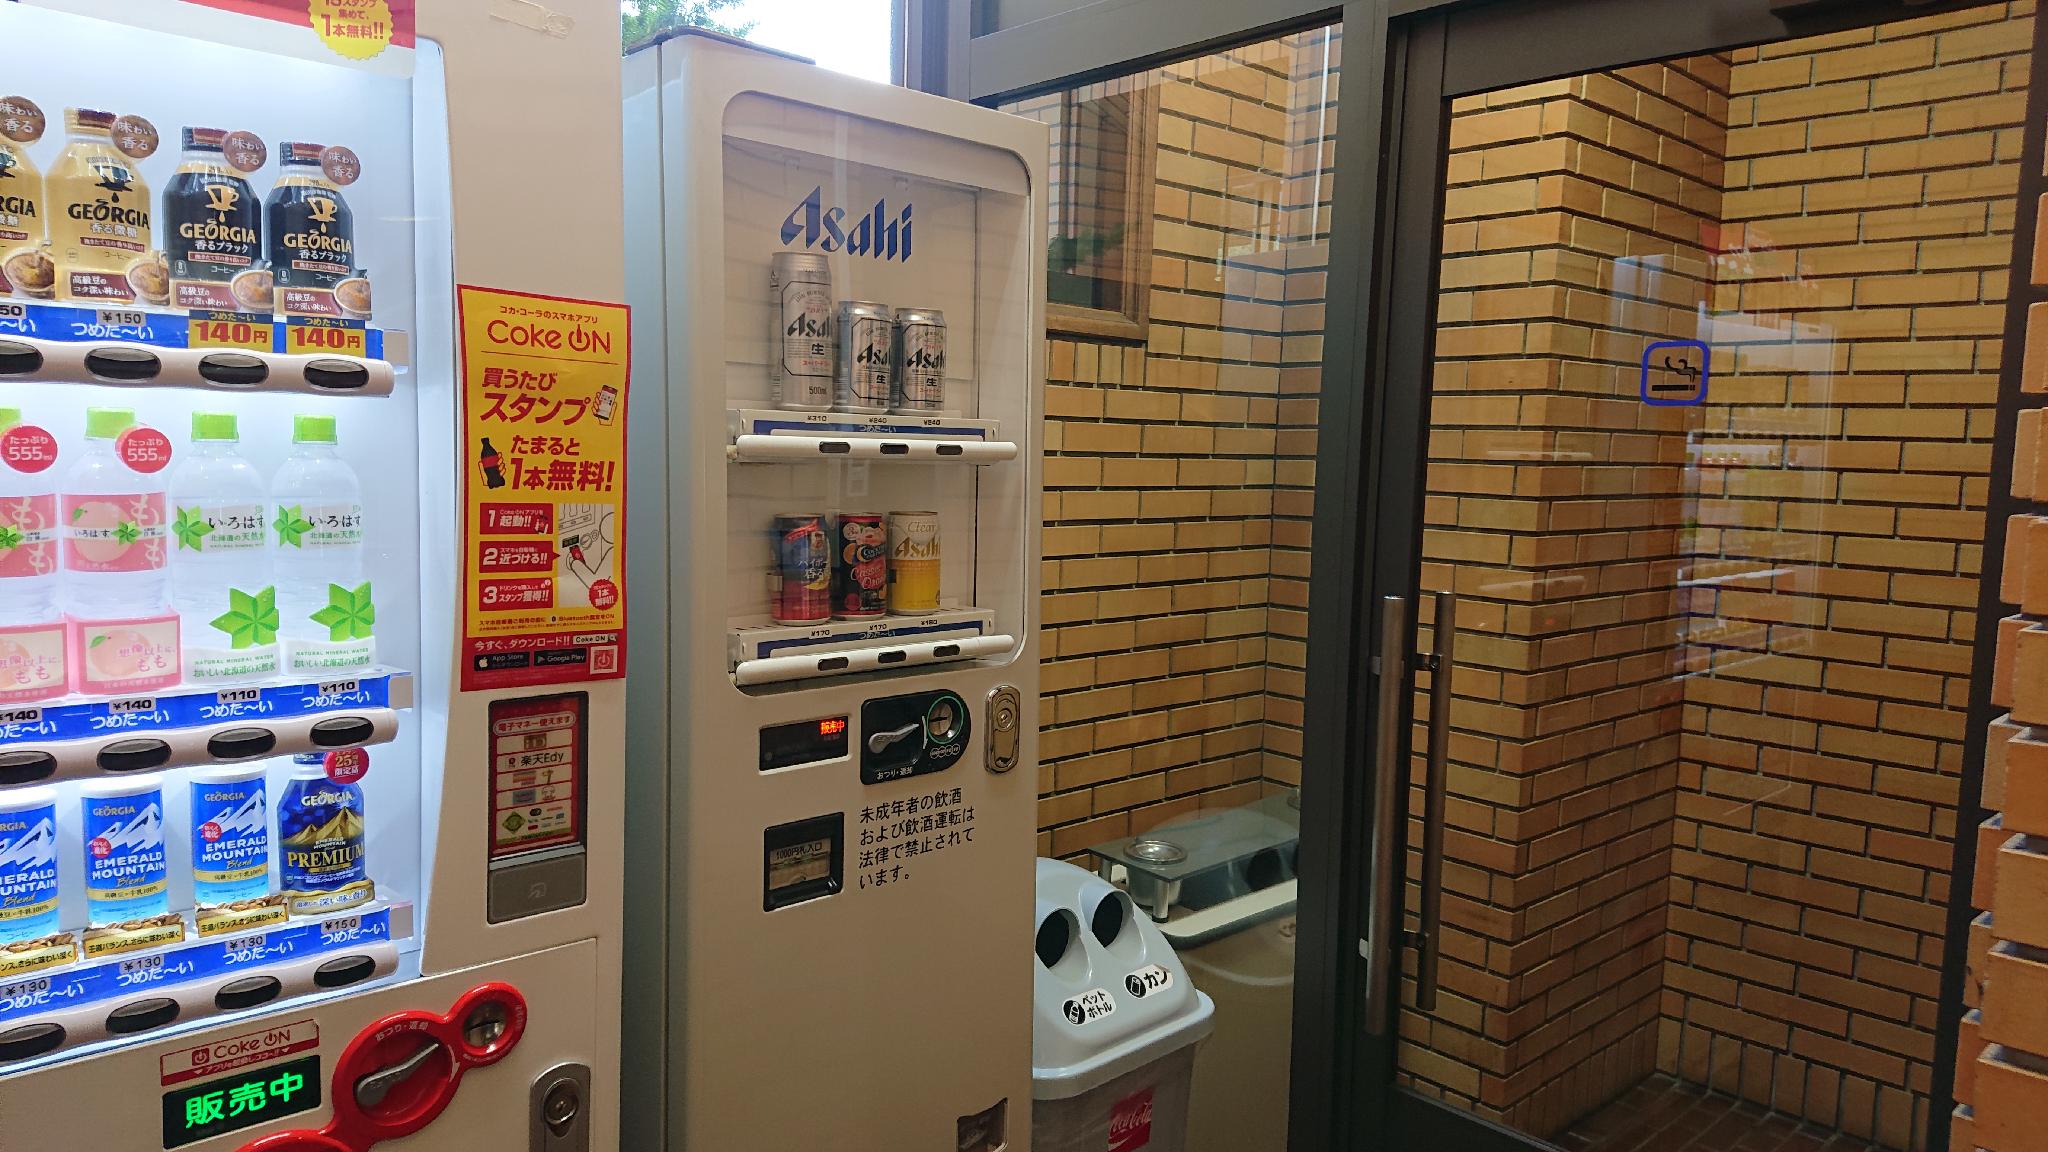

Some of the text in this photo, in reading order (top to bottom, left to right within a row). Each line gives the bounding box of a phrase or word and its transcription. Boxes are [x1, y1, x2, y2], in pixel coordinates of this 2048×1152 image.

[320, 13, 384, 39] 1本無料!!
[4, 119, 34, 133] 香る
[117, 121, 153, 135] 味わい
[121, 137, 149, 150] 香る
[231, 137, 264, 151] 味わい
[235, 152, 260, 165] 香る
[328, 151, 357, 164] 味わい
[332, 166, 354, 179] 香る
[67, 198, 150, 231] GEORGIA
[179, 218, 256, 244] GEORGIA
[780, 185, 913, 263] Asahi
[194, 239, 249, 254] 香るブラック
[283, 229, 353, 255] GEORGIA
[299, 249, 347, 263] 香るブラック
[102, 311, 142, 324] ¥150
[500, 305, 598, 324] コカ・コーラのスマホアプリ
[194, 321, 268, 344] 140円
[291, 327, 361, 348] 140円
[487, 319, 611, 354] Coke ON
[811, 343, 825, 356] 生
[482, 367, 558, 391] 買うたび
[876, 374, 887, 385] 生
[926, 377, 938, 387] 生
[808, 386, 828, 395] 500ml
[480, 392, 592, 426] スタンプ
[807, 415, 827, 423] ¥310
[9, 435, 49, 445] たっぷり
[127, 438, 164, 446] たっぷり
[510, 434, 580, 456] たまると
[8, 446, 53, 461] 555ml
[127, 448, 167, 462] 555ml
[488, 510, 496, 528] 1
[500, 515, 532, 528] 起動!!
[907, 520, 936, 533] Clear
[483, 547, 498, 566] 2
[499, 552, 548, 565] 近づける!!
[483, 586, 498, 604] 3
[499, 590, 549, 602] スタンプ獲得!!
[811, 629, 830, 637] ¥170
[475, 635, 570, 651] 今すぐ、ダウンロード!!
[137, 654, 167, 672] もも
[15, 665, 50, 684] もも
[321, 681, 356, 692] ¥110
[220, 689, 257, 701] ¥110
[113, 699, 151, 711] ¥140
[820, 720, 845, 735] 販売中
[520, 752, 564, 767] 楽天Edy
[204, 790, 245, 802] GEORGIA
[301, 790, 353, 807] GEORGIA
[92, 805, 136, 817] GEORGIA
[860, 788, 962, 824] 未成年者の飲酒
[860, 806, 975, 846] および飲酒運転は
[205, 835, 267, 852] EMERALD
[859, 827, 975, 869] 法律で禁止されて
[287, 842, 364, 868] PREMIUM
[776, 842, 823, 861] 1000円札入口
[94, 851, 163, 870] EMERALD
[92, 861, 166, 880] MOUNTAIN
[859, 864, 910, 890] います。
[325, 918, 357, 930] ¥150
[229, 935, 264, 949] ¥130
[123, 956, 161, 972] ¥130
[1143, 969, 1168, 990] カン
[5, 979, 48, 996] ¥130
[1082, 990, 1106, 1005] ペット
[1086, 1002, 1113, 1019] ボトル
[213, 1029, 291, 1059] Coke ON
[185, 1072, 304, 1129] 販売中
